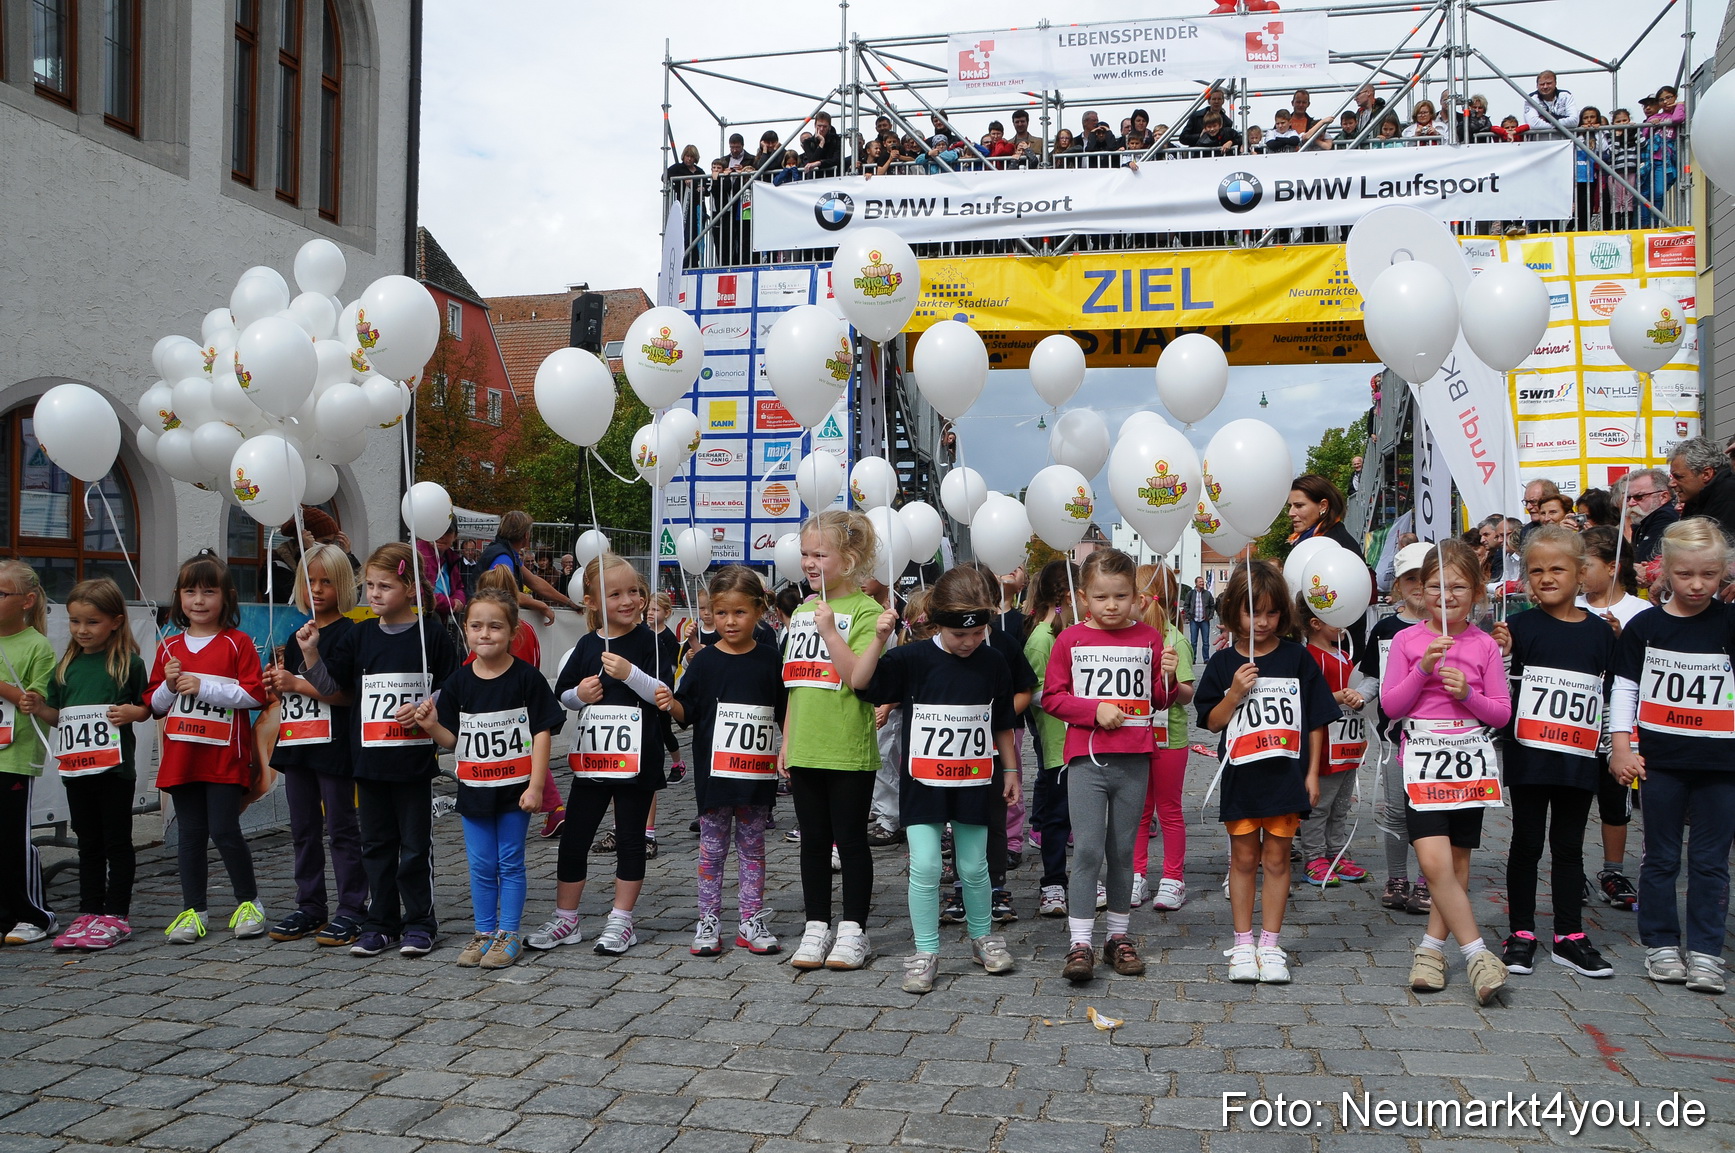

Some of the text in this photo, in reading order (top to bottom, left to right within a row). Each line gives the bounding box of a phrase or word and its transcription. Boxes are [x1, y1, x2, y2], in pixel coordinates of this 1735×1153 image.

[1058, 25, 1199, 48] LEBENSSPENDER
[1090, 48, 1167, 67] WERDEN!
[1247, 52, 1278, 61] DKMS
[959, 69, 989, 79] DKMS
[1093, 68, 1164, 80] www.dkms.de
[1274, 172, 1500, 202] BMW Laufsport
[864, 195, 1073, 220] BMW Laufsport
[1464, 246, 1496, 258] Xplus1
[1081, 267, 1215, 314] ZIEL
[957, 296, 1010, 309] Stadtlauf
[1273, 334, 1333, 344] Neumarkter
[1518, 388, 1555, 400] swn
[1458, 405, 1497, 486] Audi
[753, 533, 778, 550] Cha
[1102, 654, 1142, 664] Neumarkt
[1645, 655, 1721, 672] PARTL Neumarkt
[789, 665, 822, 678] Victoria
[364, 680, 422, 689] PARTL Neumarkt
[1080, 667, 1145, 698] 7208
[1524, 674, 1556, 685] PARTL
[1650, 669, 1725, 705] 7047
[1234, 696, 1294, 728] 7056
[1531, 686, 1598, 726] 7050
[64, 712, 103, 722] Neumarkt
[590, 712, 628, 721] Neumarkt
[718, 710, 745, 720] PARTL
[914, 712, 982, 723] PARTL Neumarkt
[1665, 710, 1704, 727] Anne
[177, 720, 206, 734] Anna
[477, 717, 516, 729] Neumarkt
[58, 721, 110, 752] 7048
[576, 725, 632, 752] 7176
[724, 721, 774, 752] 7057
[921, 727, 986, 757] 7279
[1255, 734, 1281, 749] Jeta
[1406, 735, 1481, 746] PARTL Neumarkt
[1539, 725, 1583, 745] Jule G.
[460, 727, 524, 759] 7054
[584, 757, 619, 771] Sophie
[729, 756, 770, 771] Marlene
[936, 763, 971, 777] Sarah
[1414, 748, 1487, 780] 7281
[471, 765, 516, 778] Simone
[1426, 786, 1486, 800] Hermine
